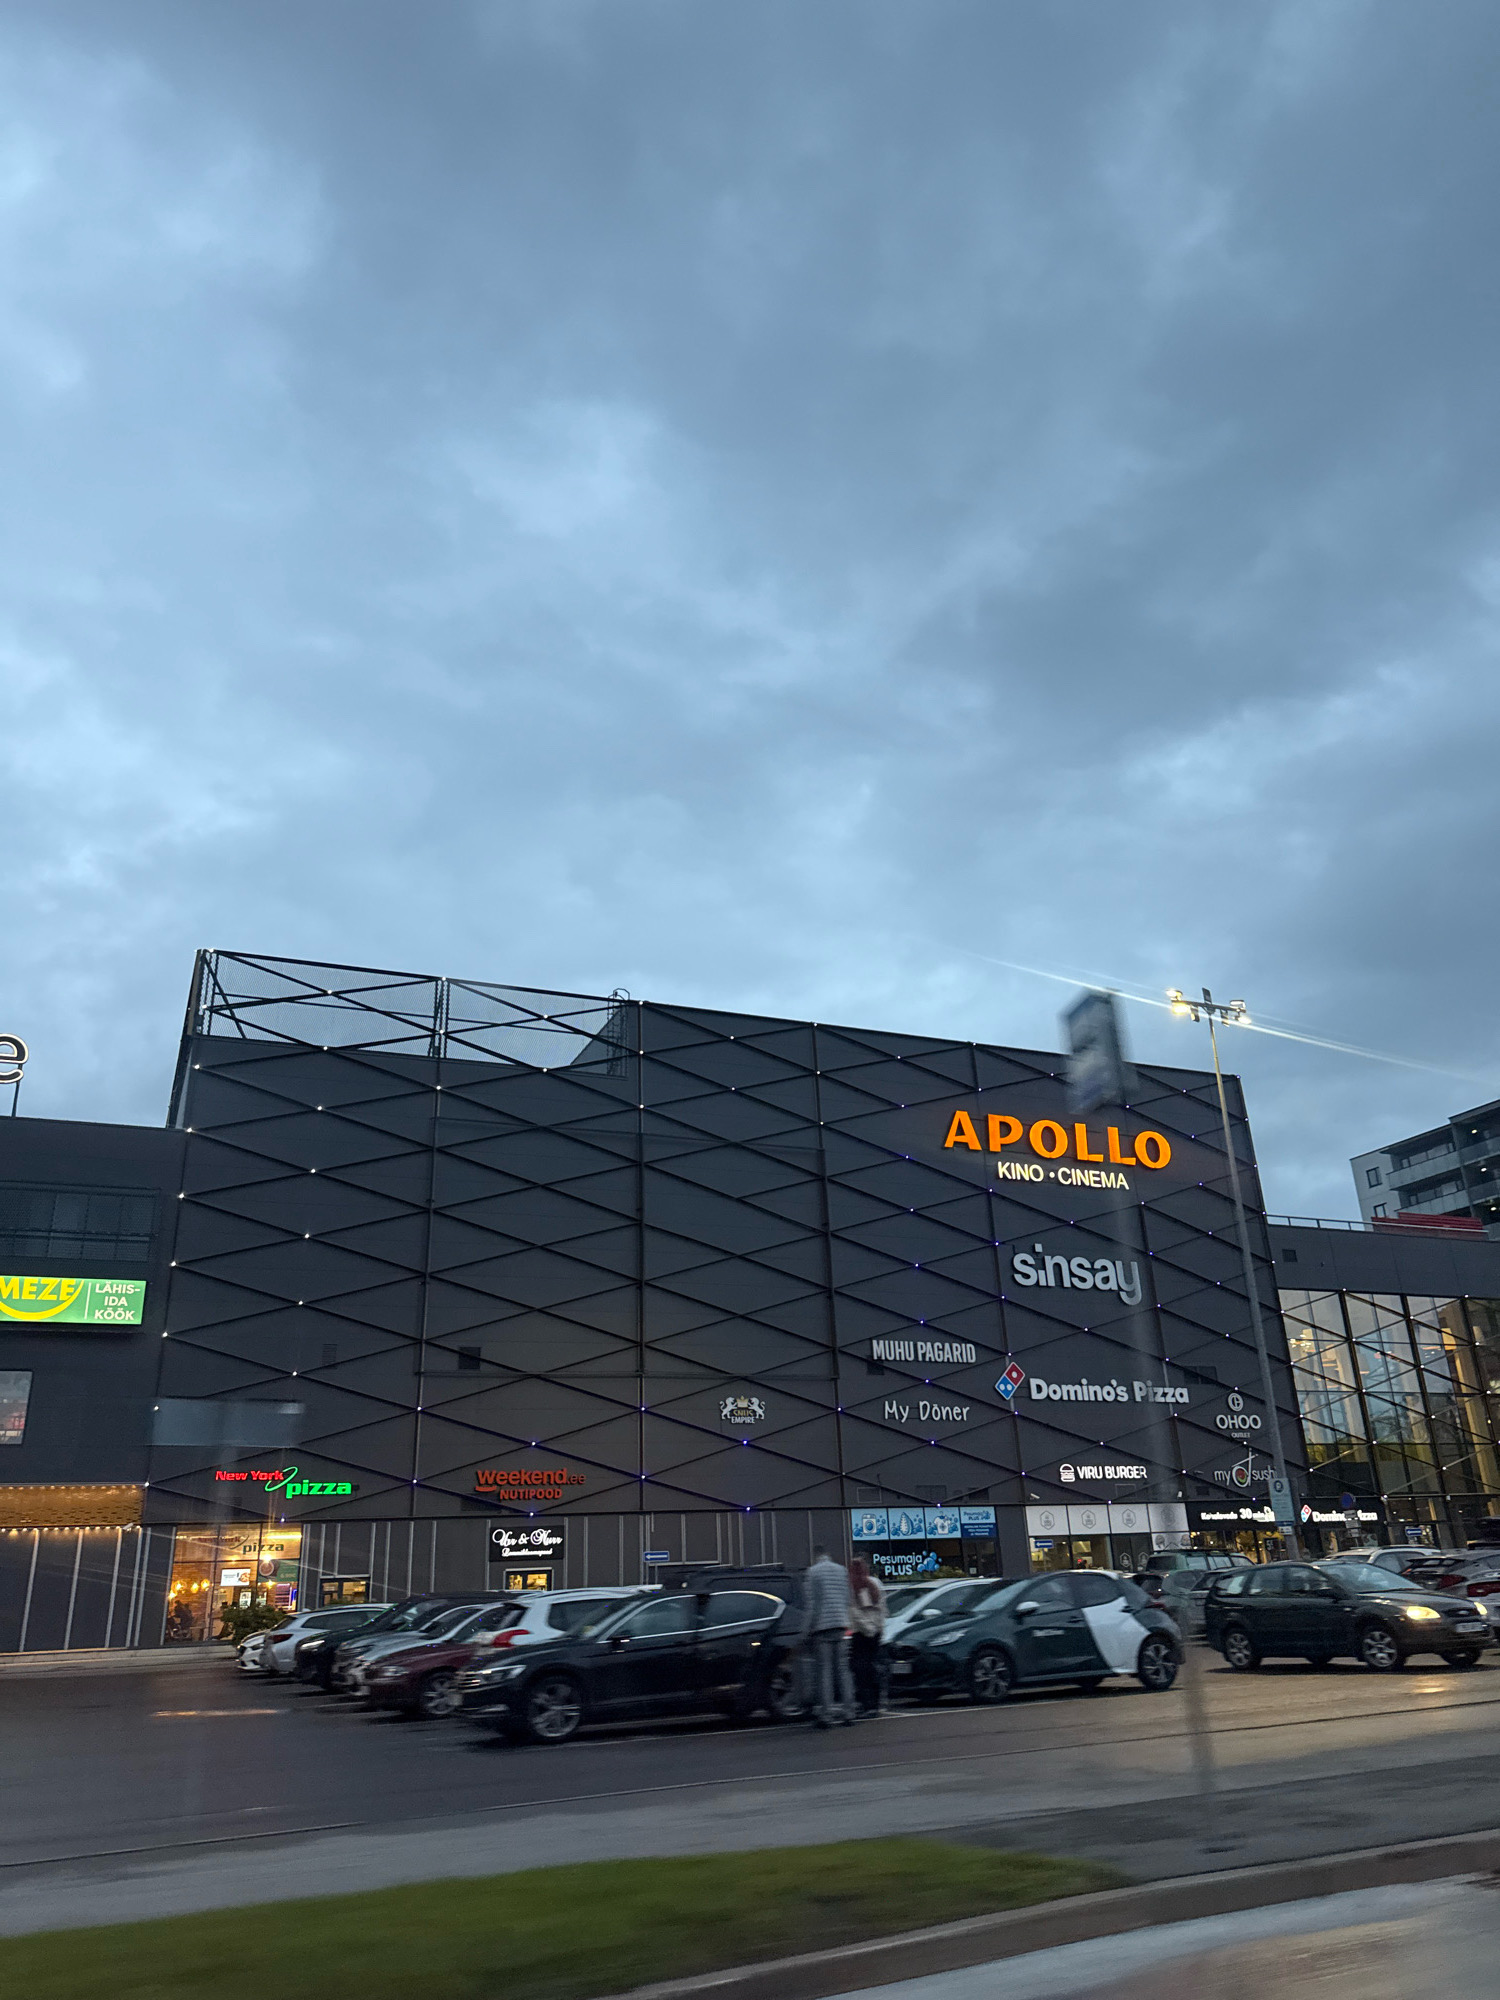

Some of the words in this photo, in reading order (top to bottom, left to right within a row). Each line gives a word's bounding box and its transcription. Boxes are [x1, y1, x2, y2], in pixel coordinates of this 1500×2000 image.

[944, 1110, 1172, 1169] APOLLO
[998, 1161, 1044, 1182] KINO
[1057, 1167, 1130, 1190] CINEMA
[1012, 1243, 1142, 1306] sinsay
[0, 1277, 76, 1300] MEZE
[95, 1281, 140, 1294] LÄHIS-
[103, 1296, 128, 1307] IDA
[872, 1339, 915, 1361] MUHU
[917, 1341, 977, 1364] PAGARID
[1132, 1379, 1190, 1404] Pizza
[884, 1400, 909, 1423] My
[1216, 1414, 1261, 1430] OHOO
[215, 1470, 248, 1481] New
[251, 1470, 284, 1481] York
[1076, 1465, 1103, 1479] VIRU
[1106, 1465, 1148, 1479] BURGER
[1214, 1470, 1232, 1486] my
[286, 1480, 352, 1499] pizza
[500, 1489, 562, 1499] NUTIPOOD
[1239, 1508, 1253, 1520] 30
[1312, 1510, 1349, 1522] Domin
[518, 1533, 529, 1544] &
[242, 1542, 285, 1555] pizza
[873, 1553, 922, 1567] Pesumaja
[884, 1565, 913, 1576] PLUS
